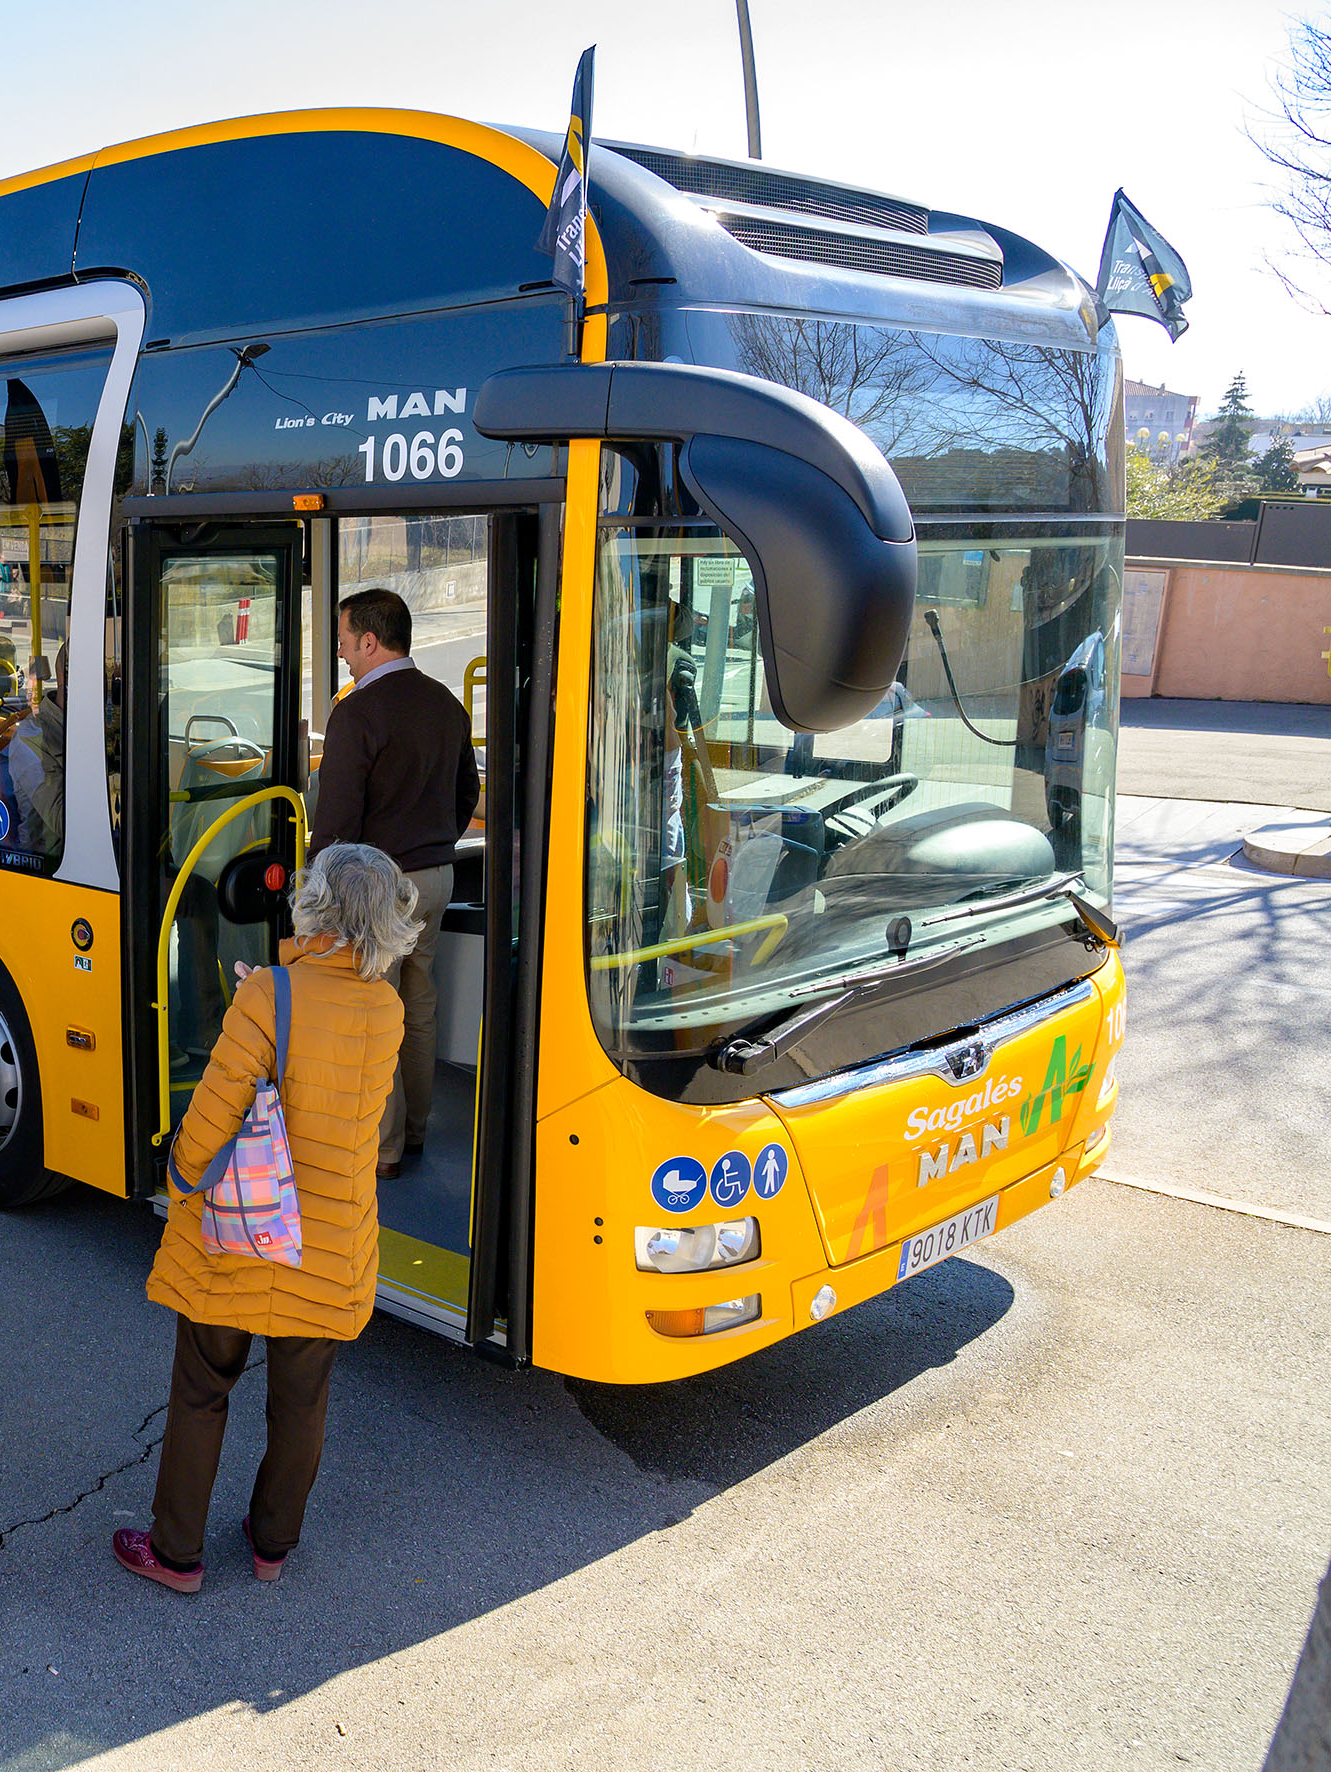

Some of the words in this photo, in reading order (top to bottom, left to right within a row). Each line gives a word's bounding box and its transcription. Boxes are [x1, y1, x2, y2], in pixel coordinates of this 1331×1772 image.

[275, 415, 315, 430] Lion's
[321, 411, 354, 426] City
[368, 387, 467, 421] MAN
[358, 428, 464, 482] 1066
[903, 1074, 1023, 1141] Sagalés
[916, 1115, 1011, 1189] MAN
[911, 1222, 957, 1268] 9018
[960, 1202, 994, 1244] KTK
